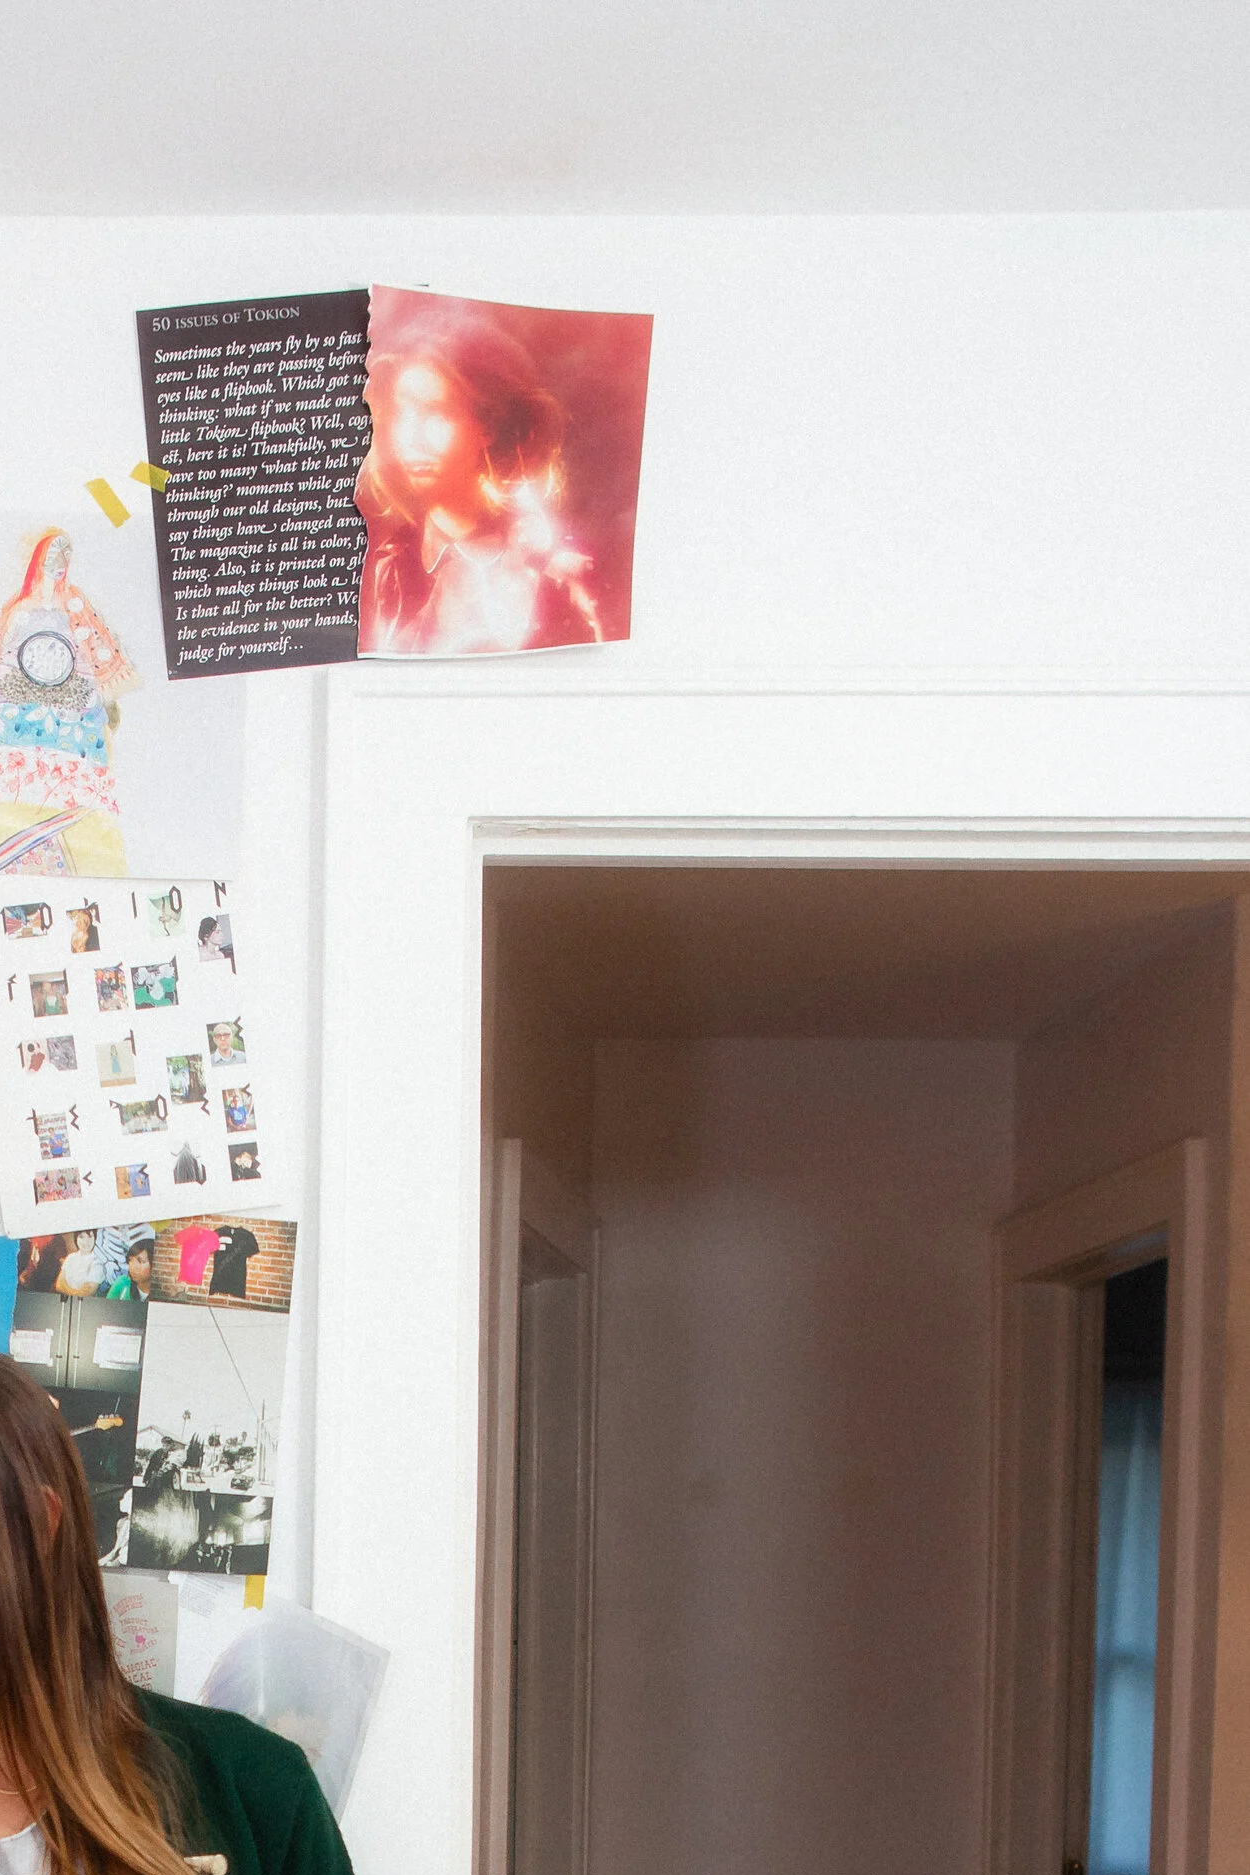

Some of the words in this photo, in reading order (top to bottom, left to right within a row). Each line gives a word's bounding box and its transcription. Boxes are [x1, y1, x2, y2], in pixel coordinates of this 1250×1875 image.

[152, 316, 171, 332] 50
[175, 314, 219, 330] ISSUES
[222, 312, 241, 324] OF
[243, 306, 300, 323] TOKION
[154, 344, 223, 364] Sometimes
[225, 340, 247, 357] the
[247, 340, 285, 359] years
[283, 335, 302, 356] fly
[304, 333, 321, 353] by
[322, 335, 338, 351] so
[336, 330, 363, 351] fast
[154, 370, 194, 384] seem
[196, 363, 220, 380] like
[223, 361, 250, 380] they
[253, 361, 275, 374] are
[276, 354, 326, 377] passing
[328, 350, 367, 371] before
[157, 391, 182, 408] eyes
[184, 385, 208, 402] like
[210, 387, 221, 399] a
[221, 378, 277, 403] flipbook.
[281, 373, 325, 393] Which
[325, 373, 350, 393] got
[159, 406, 220, 425] thinking:
[223, 402, 258, 418] what
[260, 398, 274, 419] if
[272, 399, 292, 414] we
[295, 393, 332, 412] made
[334, 395, 359, 408] our
[160, 427, 191, 445] little
[196, 424, 250, 443] Tokion
[248, 417, 307, 441] flipbook?
[310, 412, 345, 431] Well,
[186, 447, 214, 463] here
[217, 444, 229, 460] it
[231, 443, 248, 458] is!
[250, 435, 327, 457] Thankfully,
[330, 436, 359, 449] we
[197, 469, 217, 481] too
[219, 465, 258, 480] many
[301, 456, 322, 472] the
[324, 452, 349, 470] hell
[236, 481, 295, 497] moments
[297, 474, 332, 492] while
[167, 504, 220, 524] through
[222, 505, 247, 517] our
[248, 499, 270, 516] old
[272, 497, 323, 516] designs,
[325, 490, 356, 509] but
[168, 530, 190, 546] say
[192, 524, 234, 542] things
[236, 521, 278, 536] have
[280, 514, 334, 535] changed
[170, 546, 197, 562] The
[199, 540, 264, 561] magazine
[267, 539, 278, 553] is
[280, 536, 299, 552] all
[301, 536, 317, 551] in
[320, 533, 352, 550] color,
[172, 565, 211, 583] thing.
[213, 561, 247, 577] Also,
[250, 559, 262, 574] it
[264, 558, 276, 573] is
[276, 554, 326, 576] printed
[329, 556, 346, 568] on
[173, 583, 212, 601] which
[215, 579, 256, 597] makes
[258, 577, 300, 595] things
[302, 573, 328, 589] look
[331, 576, 349, 587] a
[175, 606, 188, 621] Is
[191, 603, 220, 619] that
[222, 600, 244, 619] all
[242, 599, 263, 619] for
[265, 596, 286, 612] the
[289, 593, 333, 610] better?
[177, 625, 198, 641] the
[201, 620, 260, 639] evidence
[263, 617, 278, 632] in
[279, 617, 312, 635] your
[314, 610, 358, 627] hands,
[176, 644, 215, 666] judge
[215, 642, 237, 662] for
